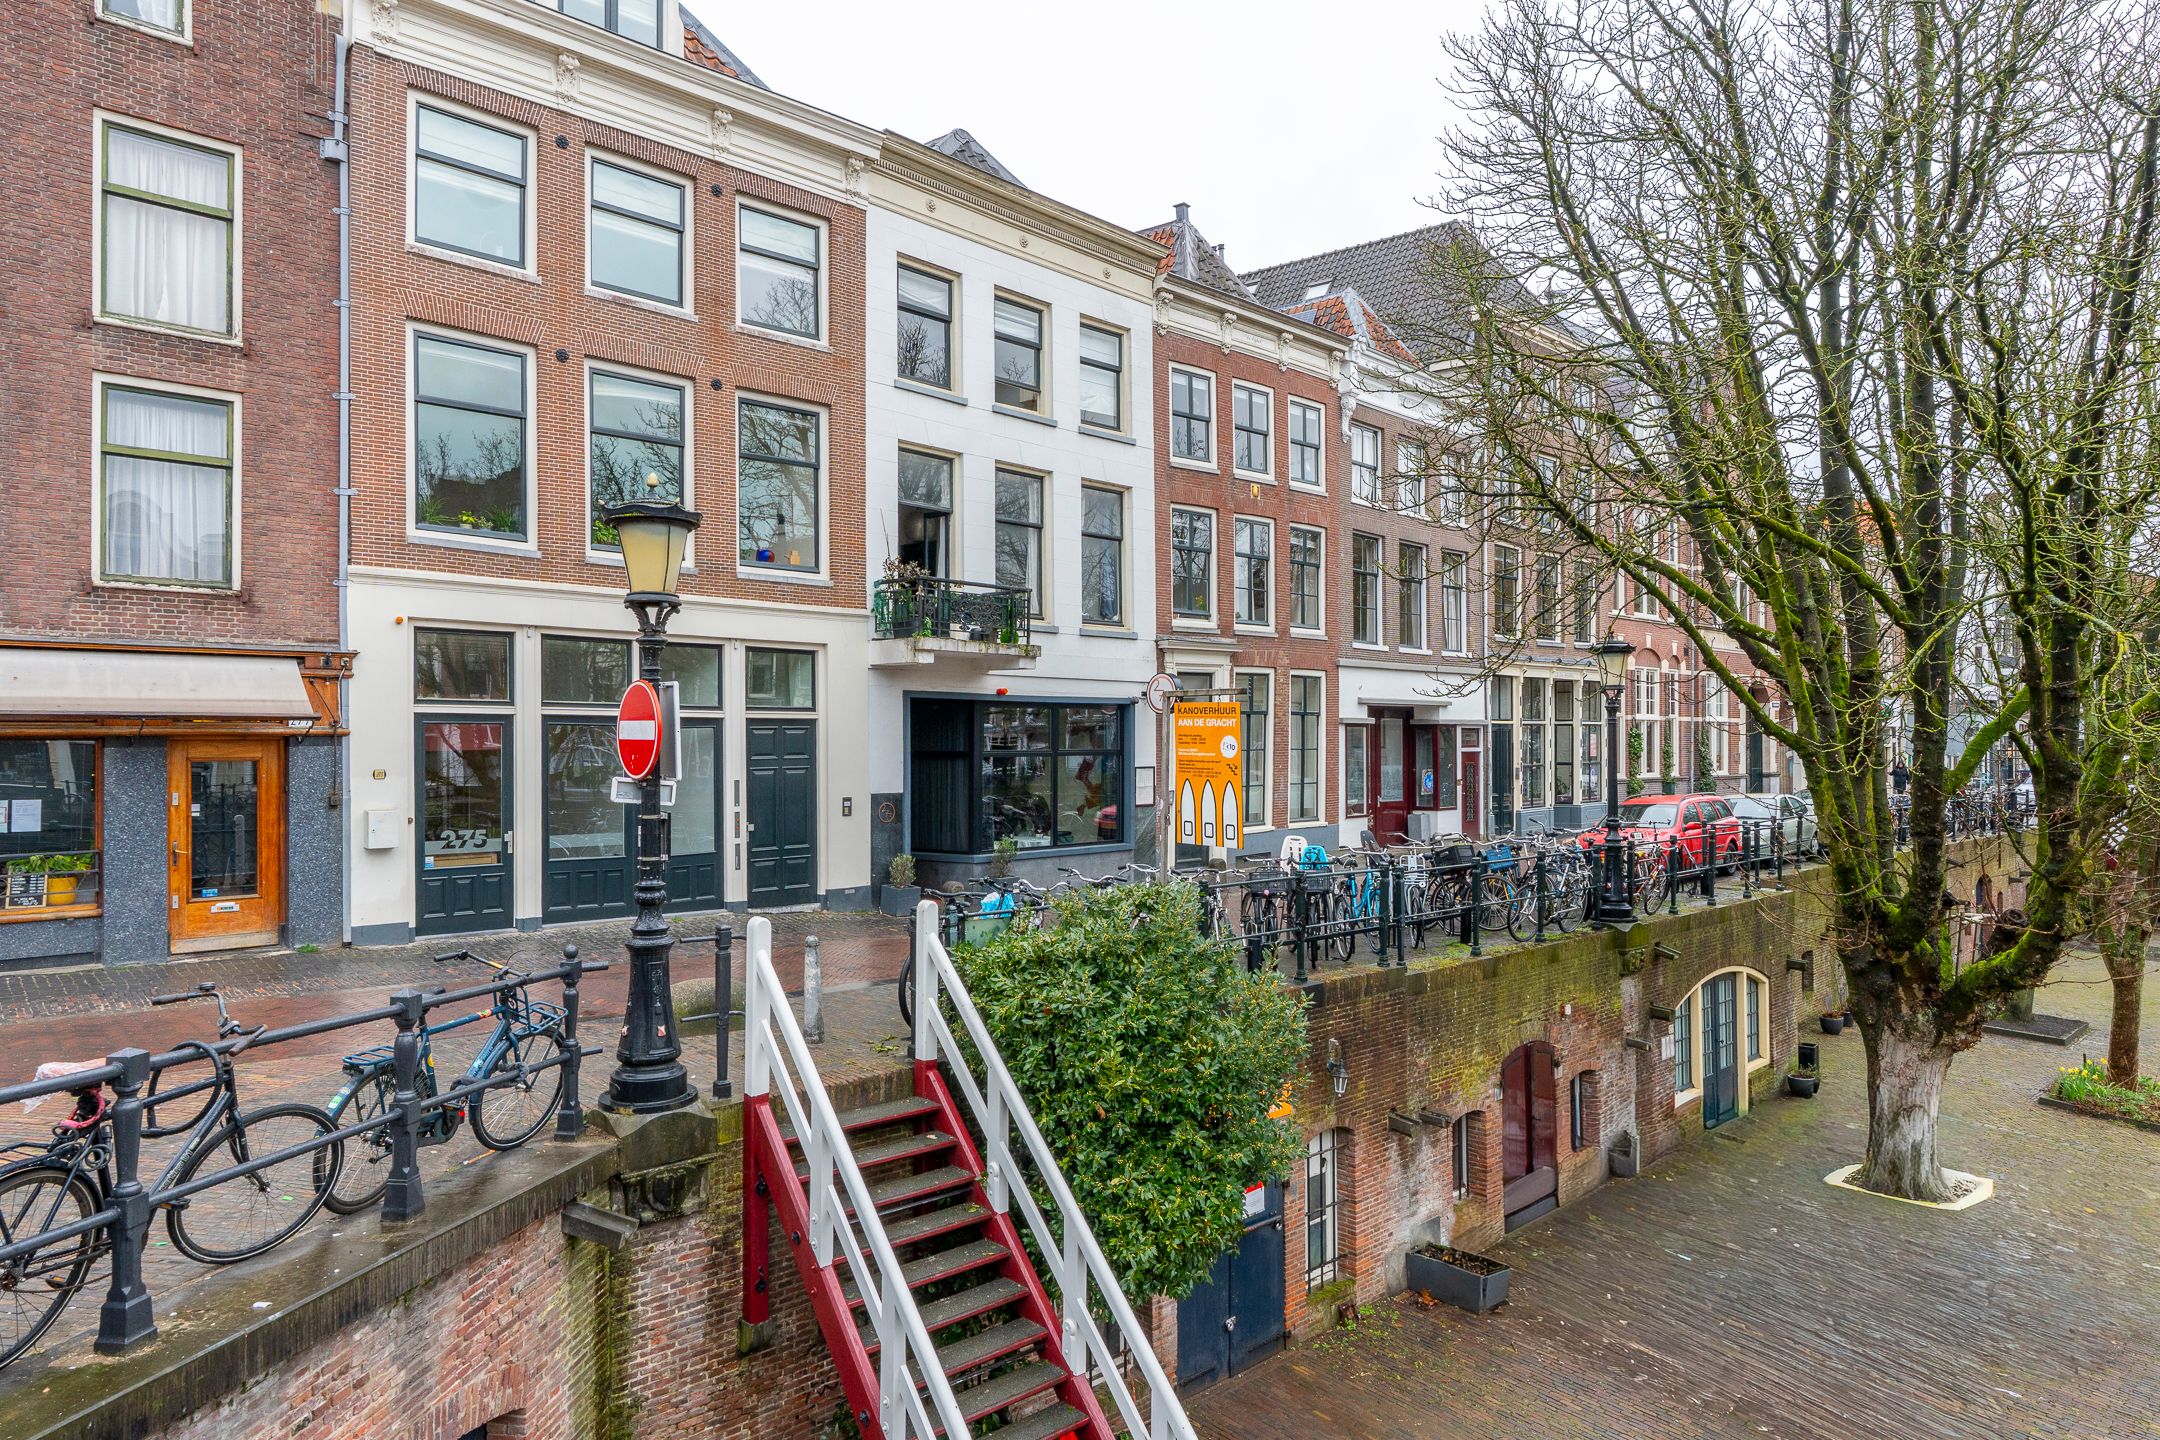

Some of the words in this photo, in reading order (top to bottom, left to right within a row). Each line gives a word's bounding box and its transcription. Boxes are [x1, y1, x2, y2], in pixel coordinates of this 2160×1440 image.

[1178, 706, 1237, 715] KANOVERHUUR
[1178, 718, 1193, 727] AAN
[1194, 718, 1205, 727] DE
[1205, 718, 1237, 727] GRACHT
[440, 829, 488, 849] 275
